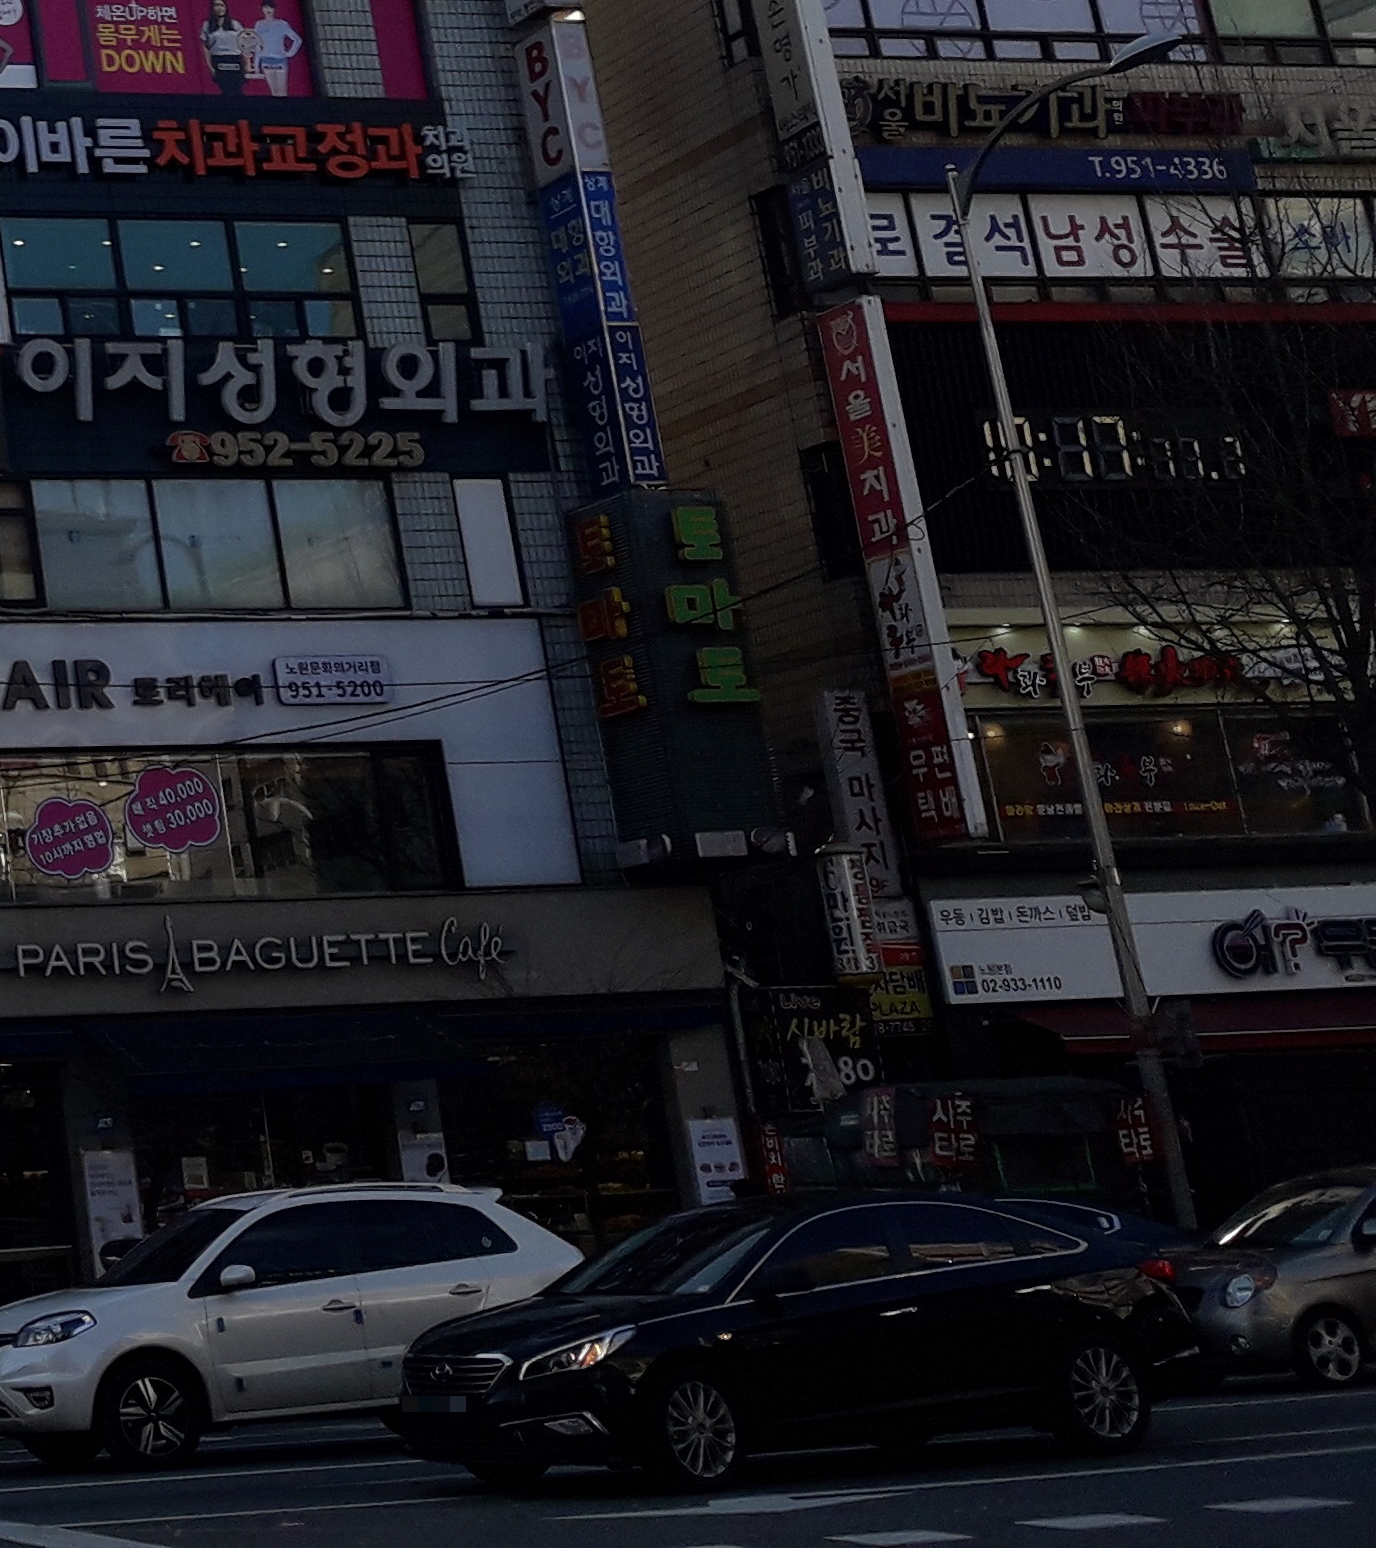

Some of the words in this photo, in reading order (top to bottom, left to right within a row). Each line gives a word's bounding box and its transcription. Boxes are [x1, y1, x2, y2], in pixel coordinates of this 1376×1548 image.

[94, 23, 185, 49] 몸무게는
[99, 49, 188, 76] DOWN
[523, 37, 565, 169] BYC
[150, 117, 425, 182] 치과교정과
[421, 126, 471, 154] 치과
[426, 150, 479, 180] 의원
[1040, 213, 1138, 270] 남성
[15, 335, 550, 429] 이지성형외과
[614, 328, 661, 481] 이지성형외과
[210, 428, 427, 472] 952-5225
[131, 673, 264, 709] 토리헤어
[286, 678, 387, 701] 951-5200
[158, 777, 205, 805] 40,000
[165, 798, 215, 829] 30,000
[939, 907, 967, 926] 우동
[977, 906, 1006, 925] 김밥
[1015, 904, 1057, 924] 돈까스
[15, 939, 156, 980] PARIS
[191, 930, 432, 975] BAGUETTE
[437, 915, 509, 985] Café
[980, 976, 1063, 993] 02-933-1110
